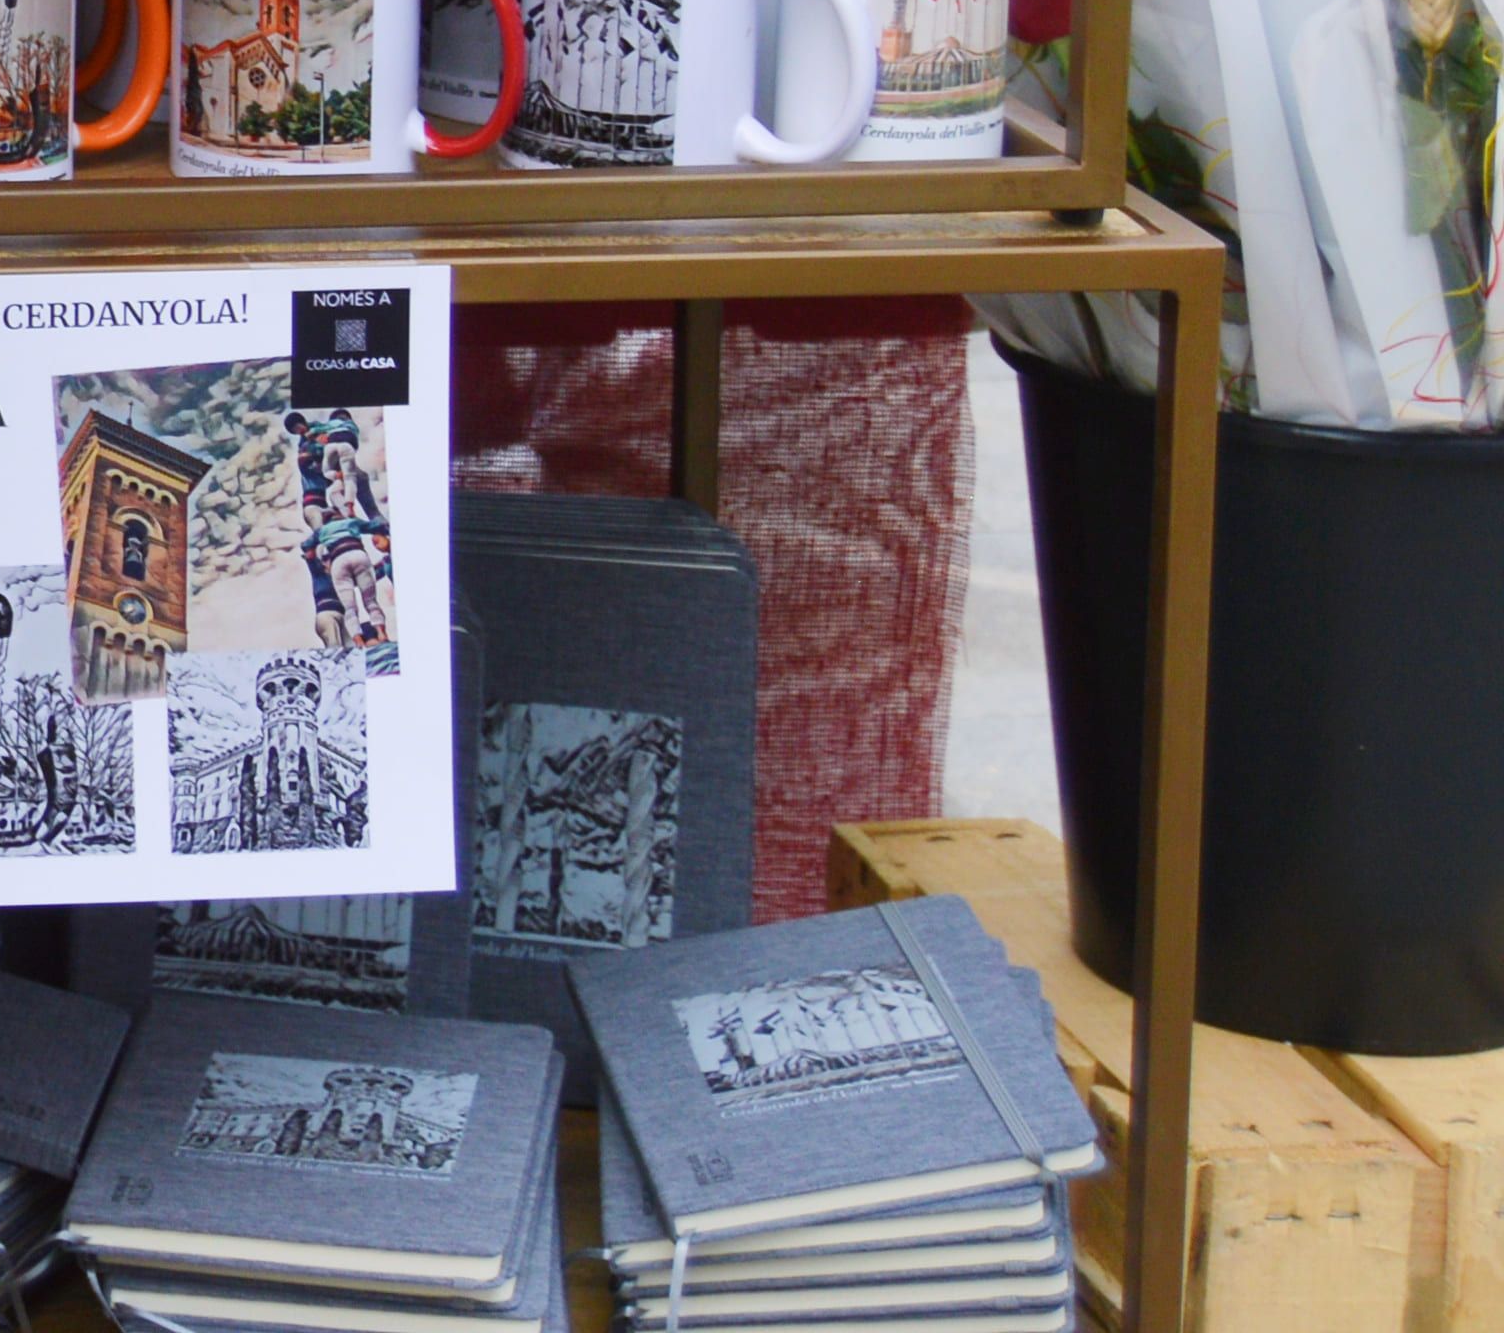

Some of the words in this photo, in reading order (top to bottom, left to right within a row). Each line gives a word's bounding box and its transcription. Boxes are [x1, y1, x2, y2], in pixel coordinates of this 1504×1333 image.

[860, 124, 935, 143] Cerdanyola
[939, 125, 957, 139] del
[313, 289, 372, 309] NOMÉS
[375, 291, 392, 309] A
[2, 292, 250, 332] CERDANYOLA!
[306, 358, 345, 372] COSAS
[346, 358, 360, 371] de
[360, 356, 396, 370] CASA
